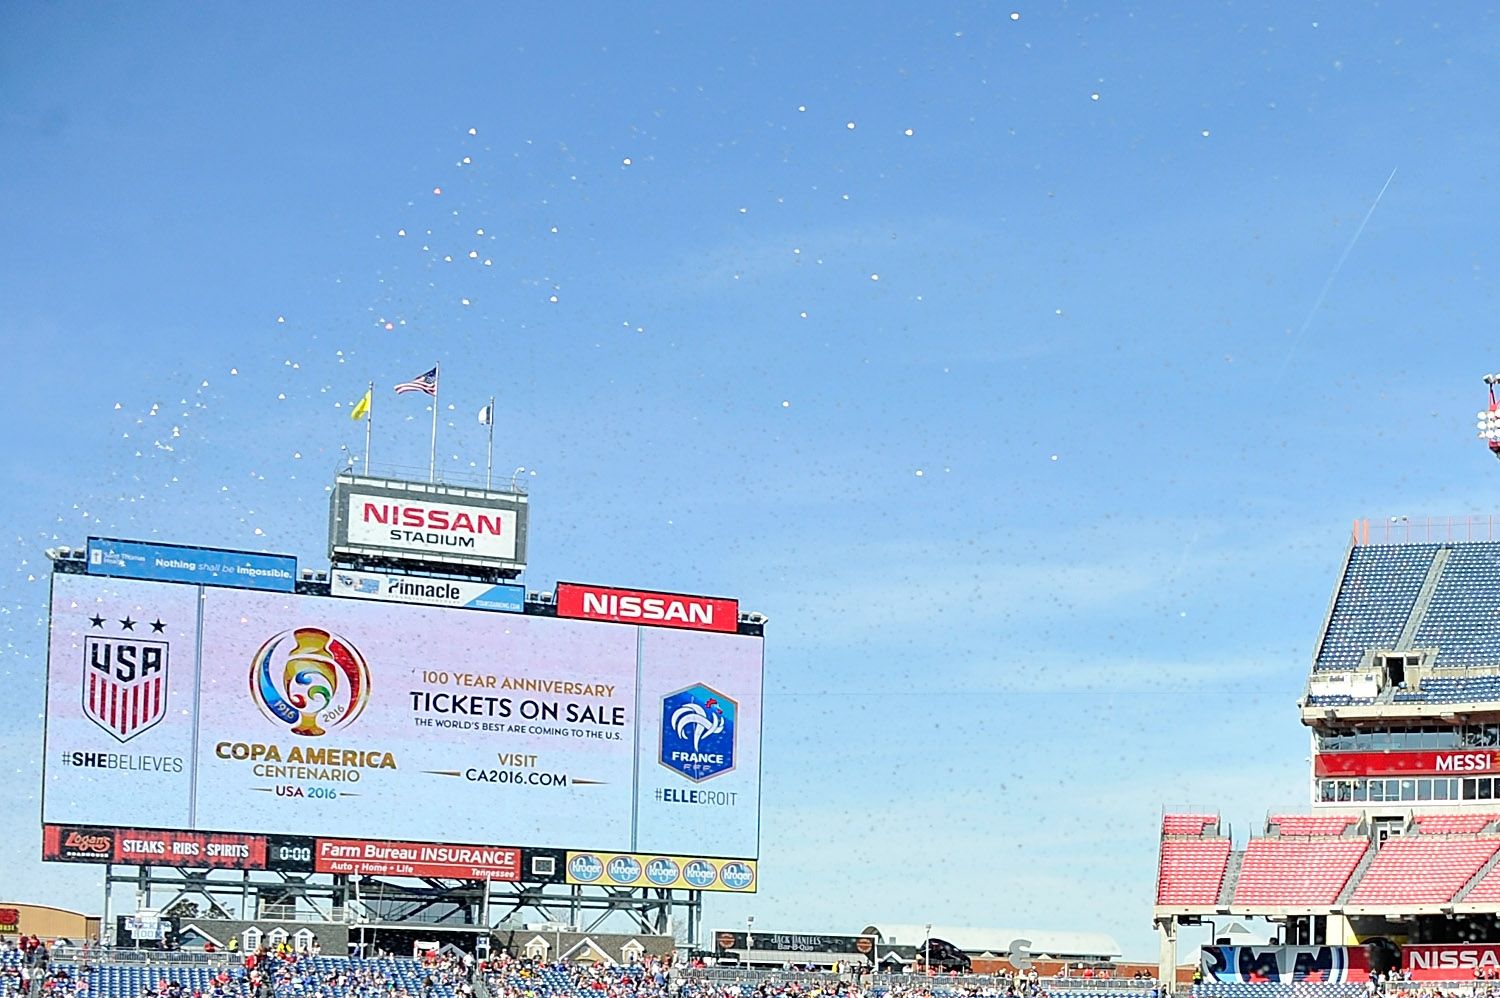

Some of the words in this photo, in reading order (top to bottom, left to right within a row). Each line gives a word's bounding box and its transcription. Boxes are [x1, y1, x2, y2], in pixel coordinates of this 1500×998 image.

[364, 503, 501, 536] NISSAN
[390, 530, 474, 548] STADIUM
[155, 558, 195, 571] Nothing
[198, 561, 220, 573] shall
[222, 563, 235, 573] be
[237, 565, 292, 579] impossible.
[388, 578, 460, 600] Pinnacle
[583, 592, 713, 625] NISSAN
[91, 643, 162, 683] USA
[422, 671, 448, 684] 100
[453, 673, 497, 688] YEAR
[501, 678, 615, 698] ANNIVERSARY
[273, 700, 297, 719] 1916
[322, 705, 345, 723] 2016
[409, 691, 512, 719] TICKETS
[520, 700, 558, 721] ON
[566, 702, 625, 726] SALE
[414, 717, 433, 727] THE
[435, 718, 480, 730] WORLD'S
[482, 721, 505, 732] BEST
[508, 724, 527, 734] ARE
[529, 725, 569, 737] COMING
[571, 728, 583, 738] TO
[585, 729, 603, 739] THE
[606, 731, 623, 741] U.S.
[62, 751, 183, 773] #SHEBELIEVES
[215, 741, 281, 763] COPA
[288, 746, 397, 770] AMERICA
[498, 753, 538, 768] VISIT
[672, 751, 724, 765] FRANCE
[1435, 753, 1491, 771] MESSI
[253, 764, 360, 783] CENTENARIO
[465, 768, 568, 787] CA2016.COM
[276, 785, 304, 798] USA
[308, 787, 337, 800] 2016
[655, 788, 738, 806] #ELLECROIT
[123, 839, 165, 854] STEAKS
[173, 843, 200, 856] RIBS
[207, 844, 249, 858] SPIRITS
[280, 846, 311, 861] 0:00
[321, 842, 361, 858] Farm
[365, 845, 417, 860] Bureau
[421, 847, 514, 865] INSURANCE
[330, 861, 353, 870] Auto
[362, 864, 387, 873] Home
[397, 864, 414, 874] Life
[471, 867, 515, 879] Tennessee
[572, 858, 601, 877] Kroger
[610, 860, 640, 879] Kroger
[649, 862, 678, 881] Kroger
[687, 864, 715, 883] Kroger
[723, 866, 752, 885] Kroger
[771, 935, 791, 945] JACK
